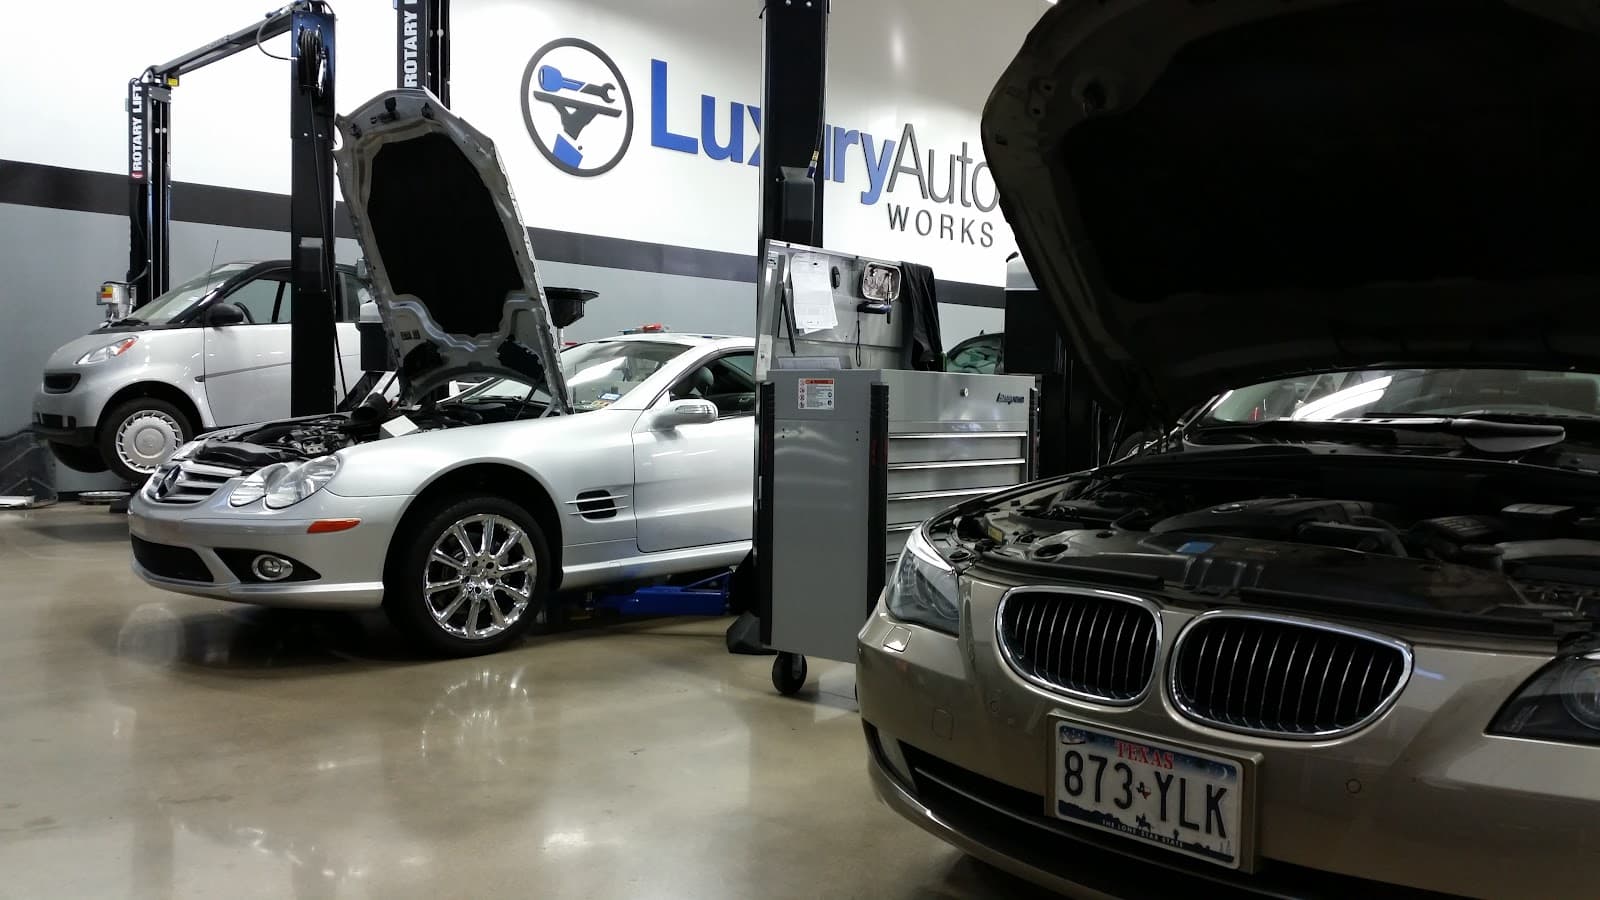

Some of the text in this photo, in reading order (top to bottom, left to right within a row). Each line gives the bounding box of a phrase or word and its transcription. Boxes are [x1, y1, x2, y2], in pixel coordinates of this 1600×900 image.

[403, 10, 418, 88] ROTARY
[132, 83, 143, 113] LIFT
[132, 117, 143, 171] ROTARY
[887, 202, 993, 248] WORKS
[1114, 739, 1175, 770] TEXAS
[1064, 750, 1227, 839] 873 YLK
[1117, 823, 1137, 835] LONE
[1161, 836, 1184, 849] STATE
